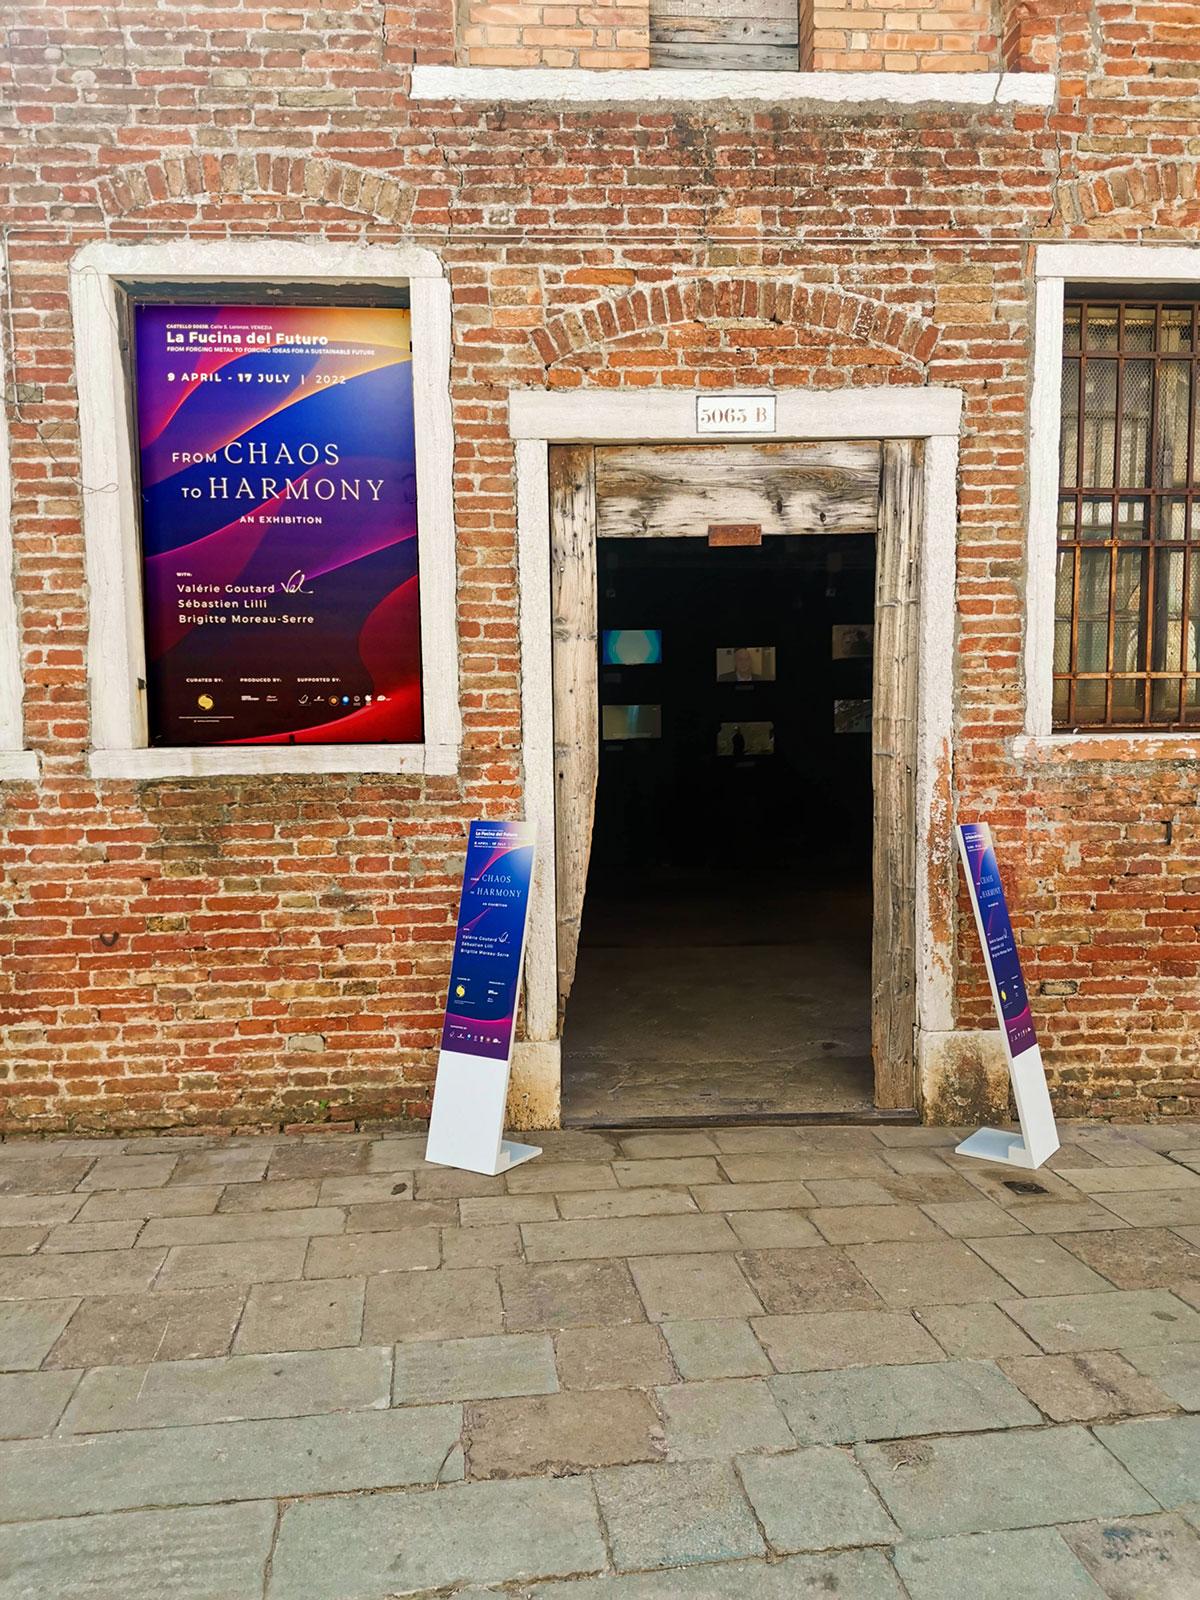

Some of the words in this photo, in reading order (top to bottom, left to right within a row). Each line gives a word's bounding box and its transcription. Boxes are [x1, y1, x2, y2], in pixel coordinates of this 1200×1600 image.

[167, 332, 184, 343] La
[189, 331, 241, 343] Fucina
[246, 332, 270, 344] del
[276, 332, 328, 345] Futuro
[167, 372, 175, 381] 9
[181, 372, 222, 382] APRIL
[238, 374, 252, 382] 17
[258, 374, 290, 383] JULY
[315, 375, 346, 384] 2022
[756, 407, 767, 422] B
[172, 452, 217, 464] FROM
[224, 442, 339, 465] CHAOS
[181, 487, 201, 499] TO
[209, 477, 384, 501] HARMONY
[240, 516, 254, 524] AN
[259, 516, 322, 524] EXHIBITION
[176, 583, 220, 593] Valérie
[225, 584, 275, 593] Goutard
[178, 599, 239, 608] Sébastien
[244, 600, 267, 608] Lilli
[179, 614, 226, 625] Brigitte
[231, 614, 314, 624] Moreau-Serre
[482, 874, 512, 883] CHAOS
[477, 888, 522, 898] HARMONY
